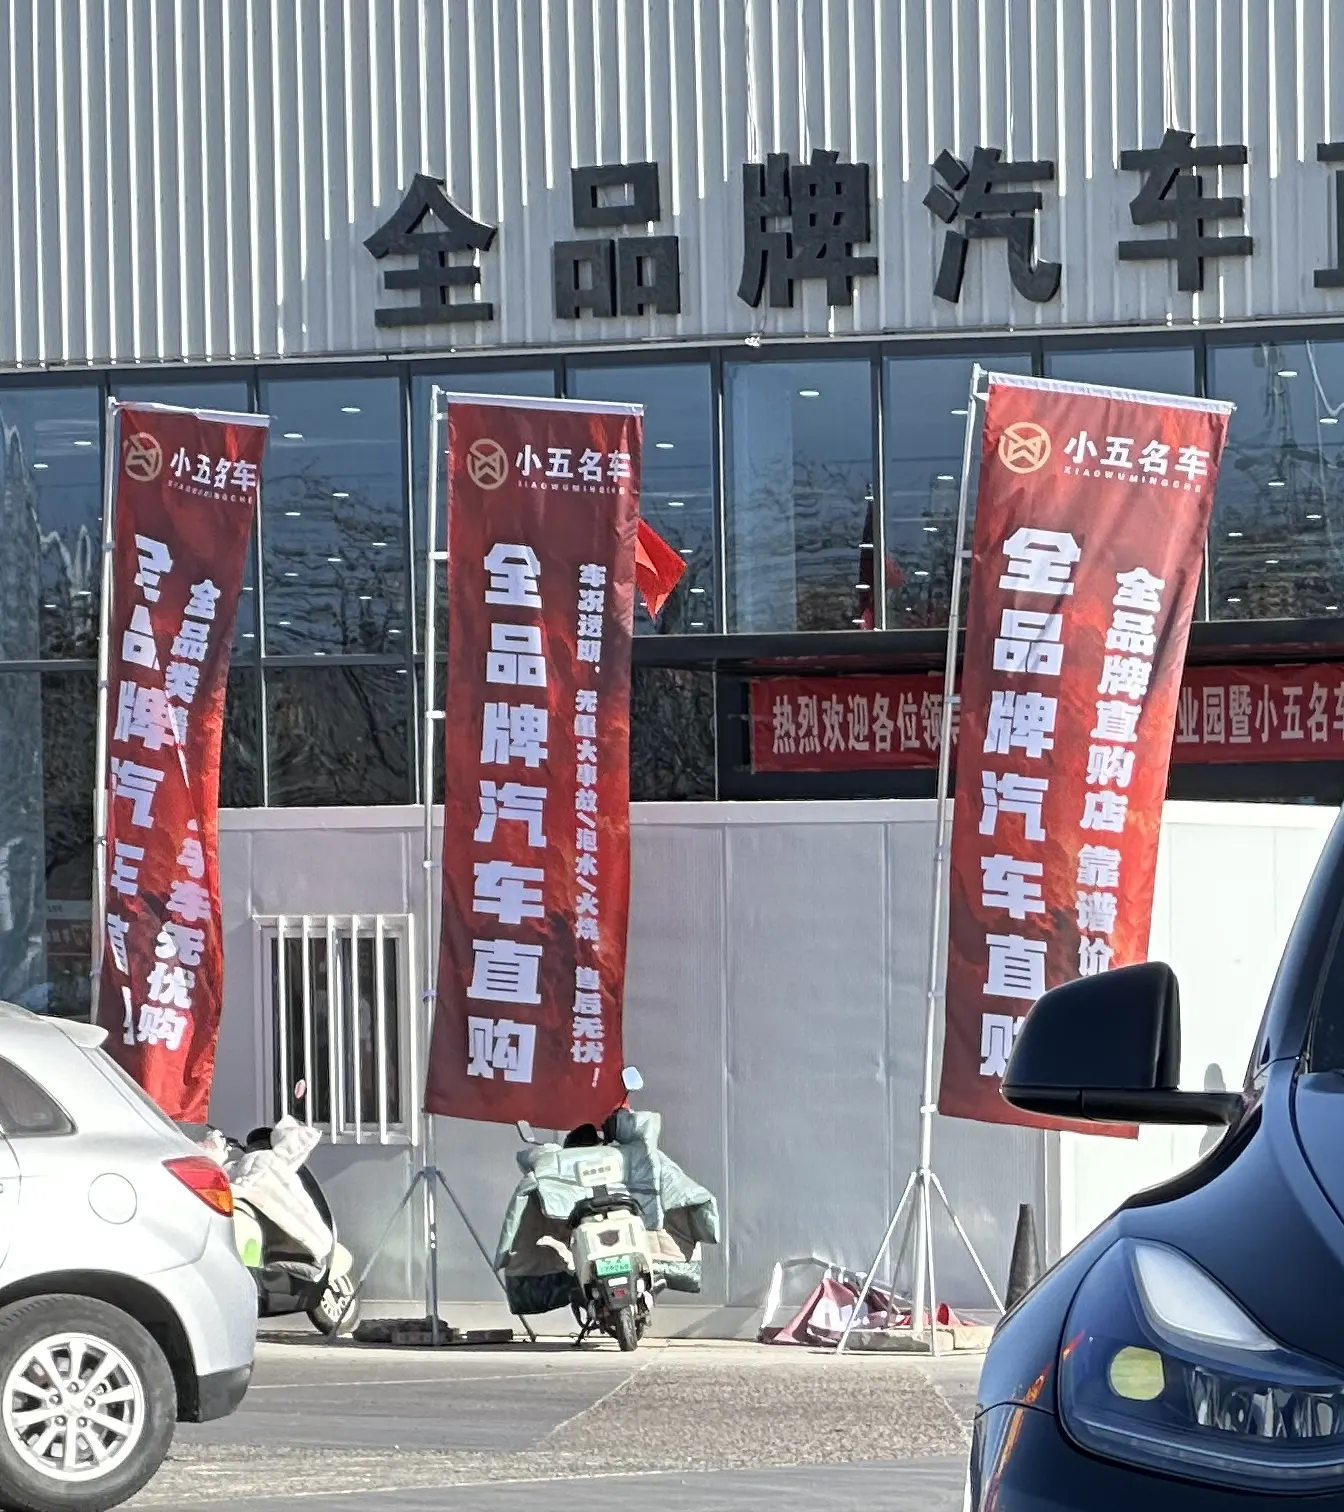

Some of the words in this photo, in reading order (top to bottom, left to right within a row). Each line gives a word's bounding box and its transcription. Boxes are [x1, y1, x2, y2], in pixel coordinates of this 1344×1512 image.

[170, 447, 256, 491] 小五名车
[515, 444, 631, 482] 小五名车
[1064, 431, 1209, 480] 小五名车
[1080, 567, 1165, 833] 全品牌直购店
[466, 542, 548, 1083] 全品牌汽车直购
